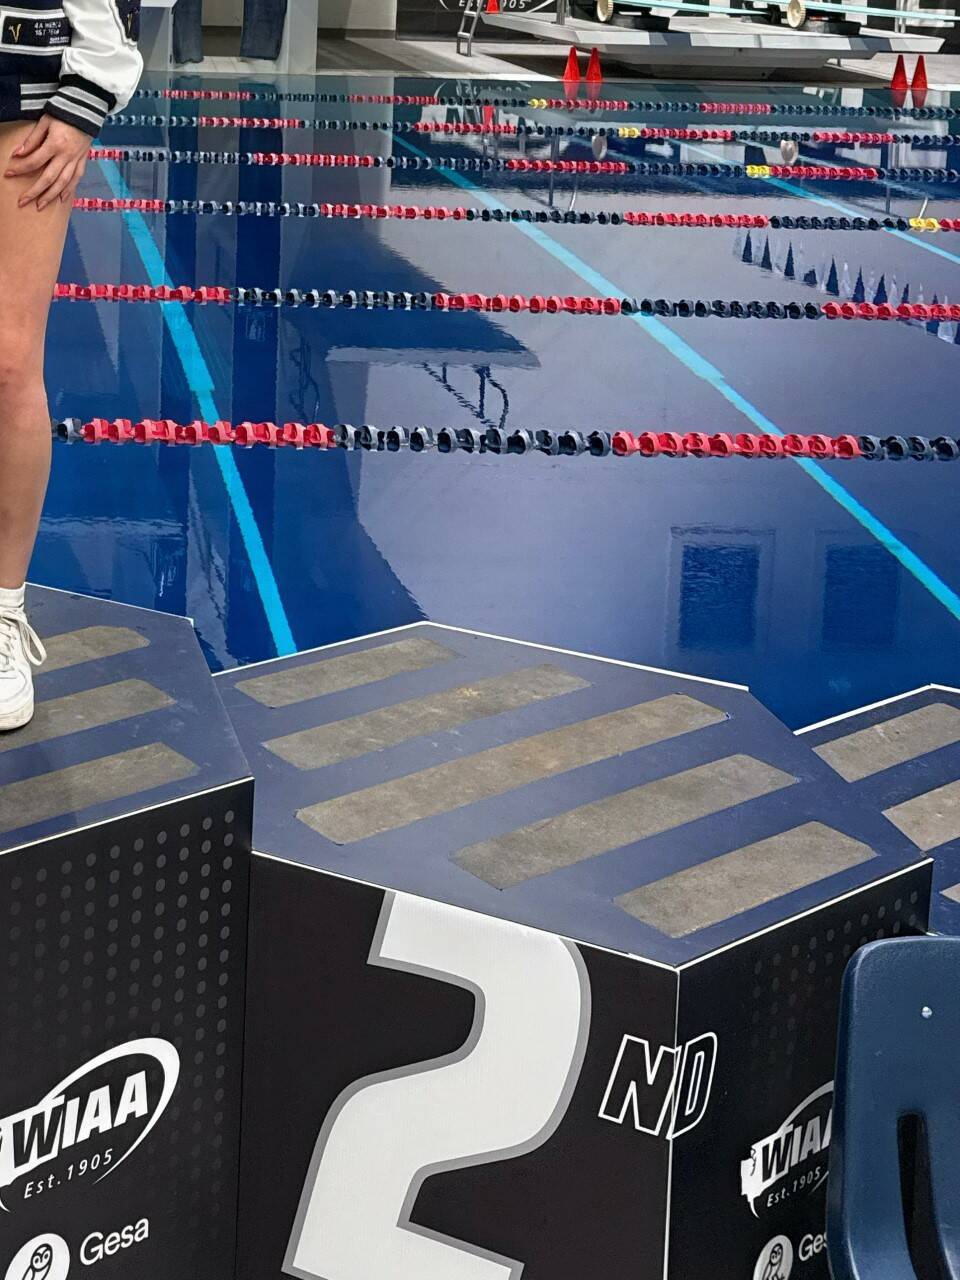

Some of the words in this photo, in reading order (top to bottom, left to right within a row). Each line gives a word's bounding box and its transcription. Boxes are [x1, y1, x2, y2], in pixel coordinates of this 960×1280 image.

[282, 889, 591, 1280] 2
[598, 1031, 718, 1140] ND
[12, 1070, 149, 1170] WIAA
[23, 1172, 62, 1199] Est.
[68, 1148, 114, 1181] 1905
[766, 1186, 790, 1208] Est.
[792, 1166, 822, 1193] 1905
[80, 1218, 150, 1265] Gesa
[798, 1231, 828, 1262] Ges
